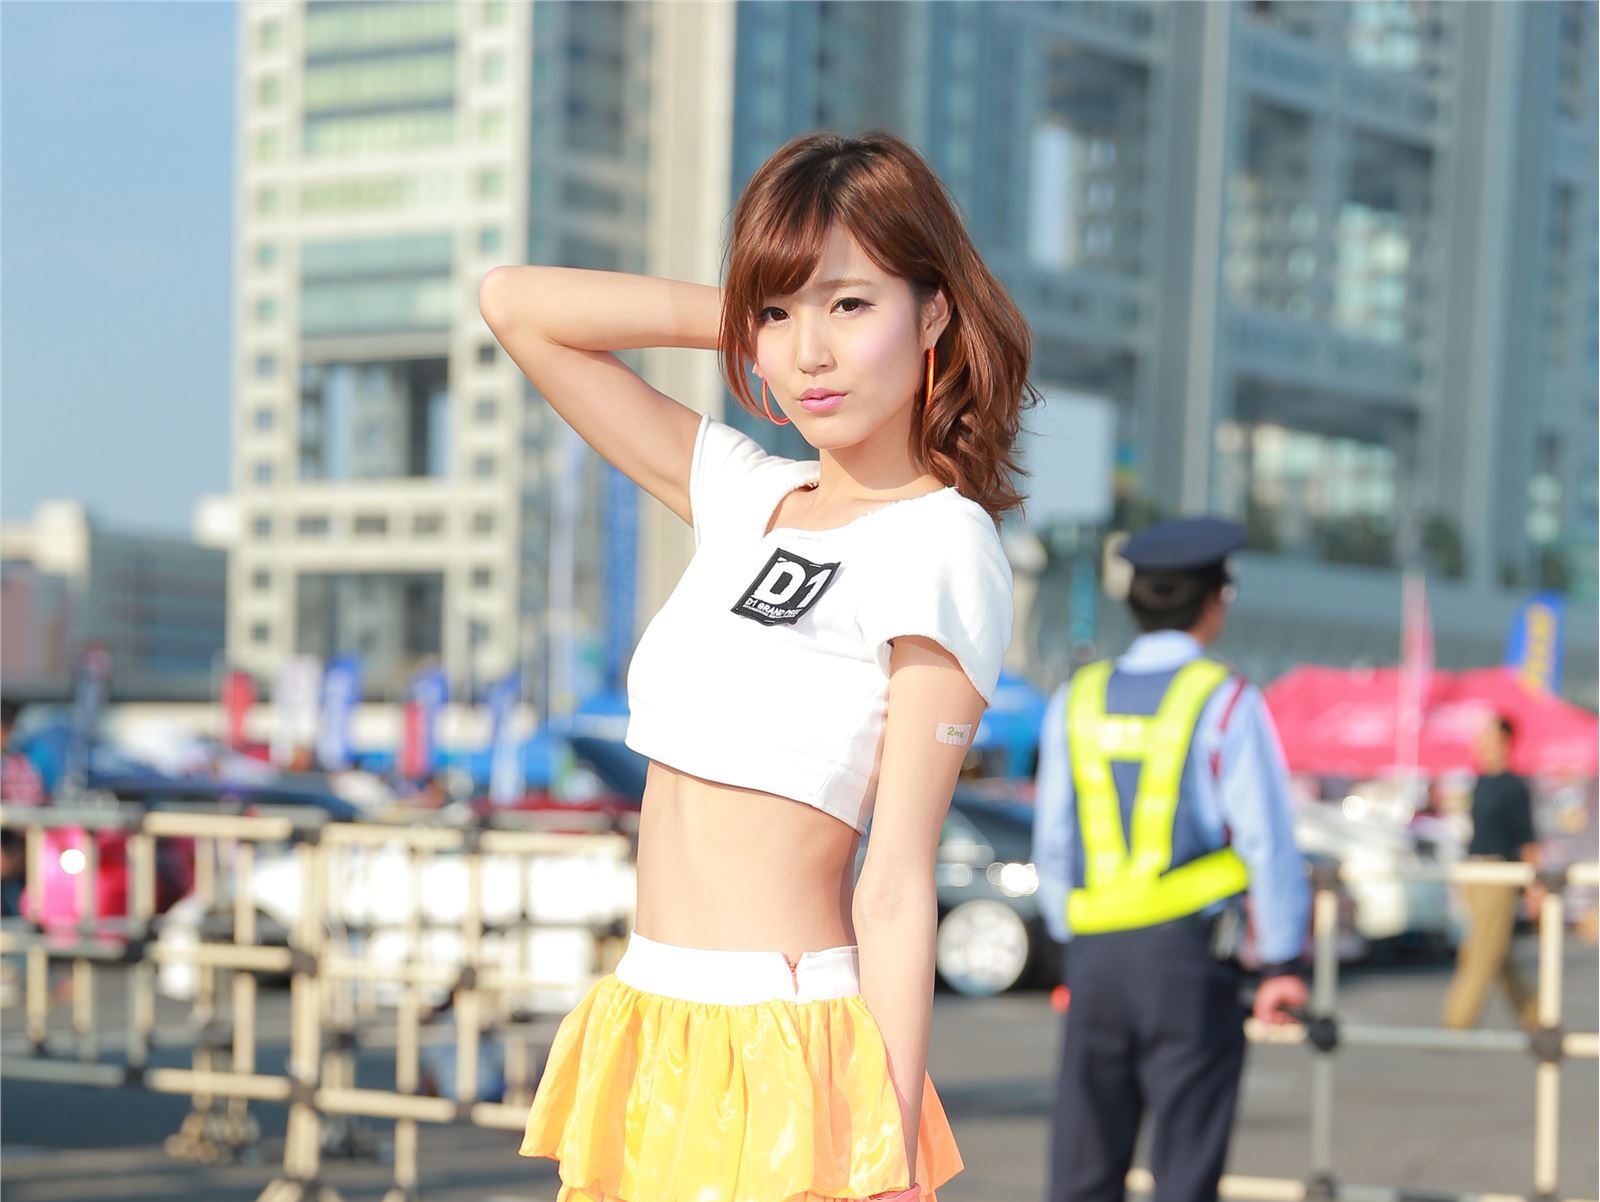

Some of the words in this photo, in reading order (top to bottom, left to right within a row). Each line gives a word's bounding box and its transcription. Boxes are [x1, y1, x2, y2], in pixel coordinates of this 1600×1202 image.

[750, 556, 832, 615] D1
[744, 597, 758, 607] D1
[757, 602, 785, 617] GRAND
